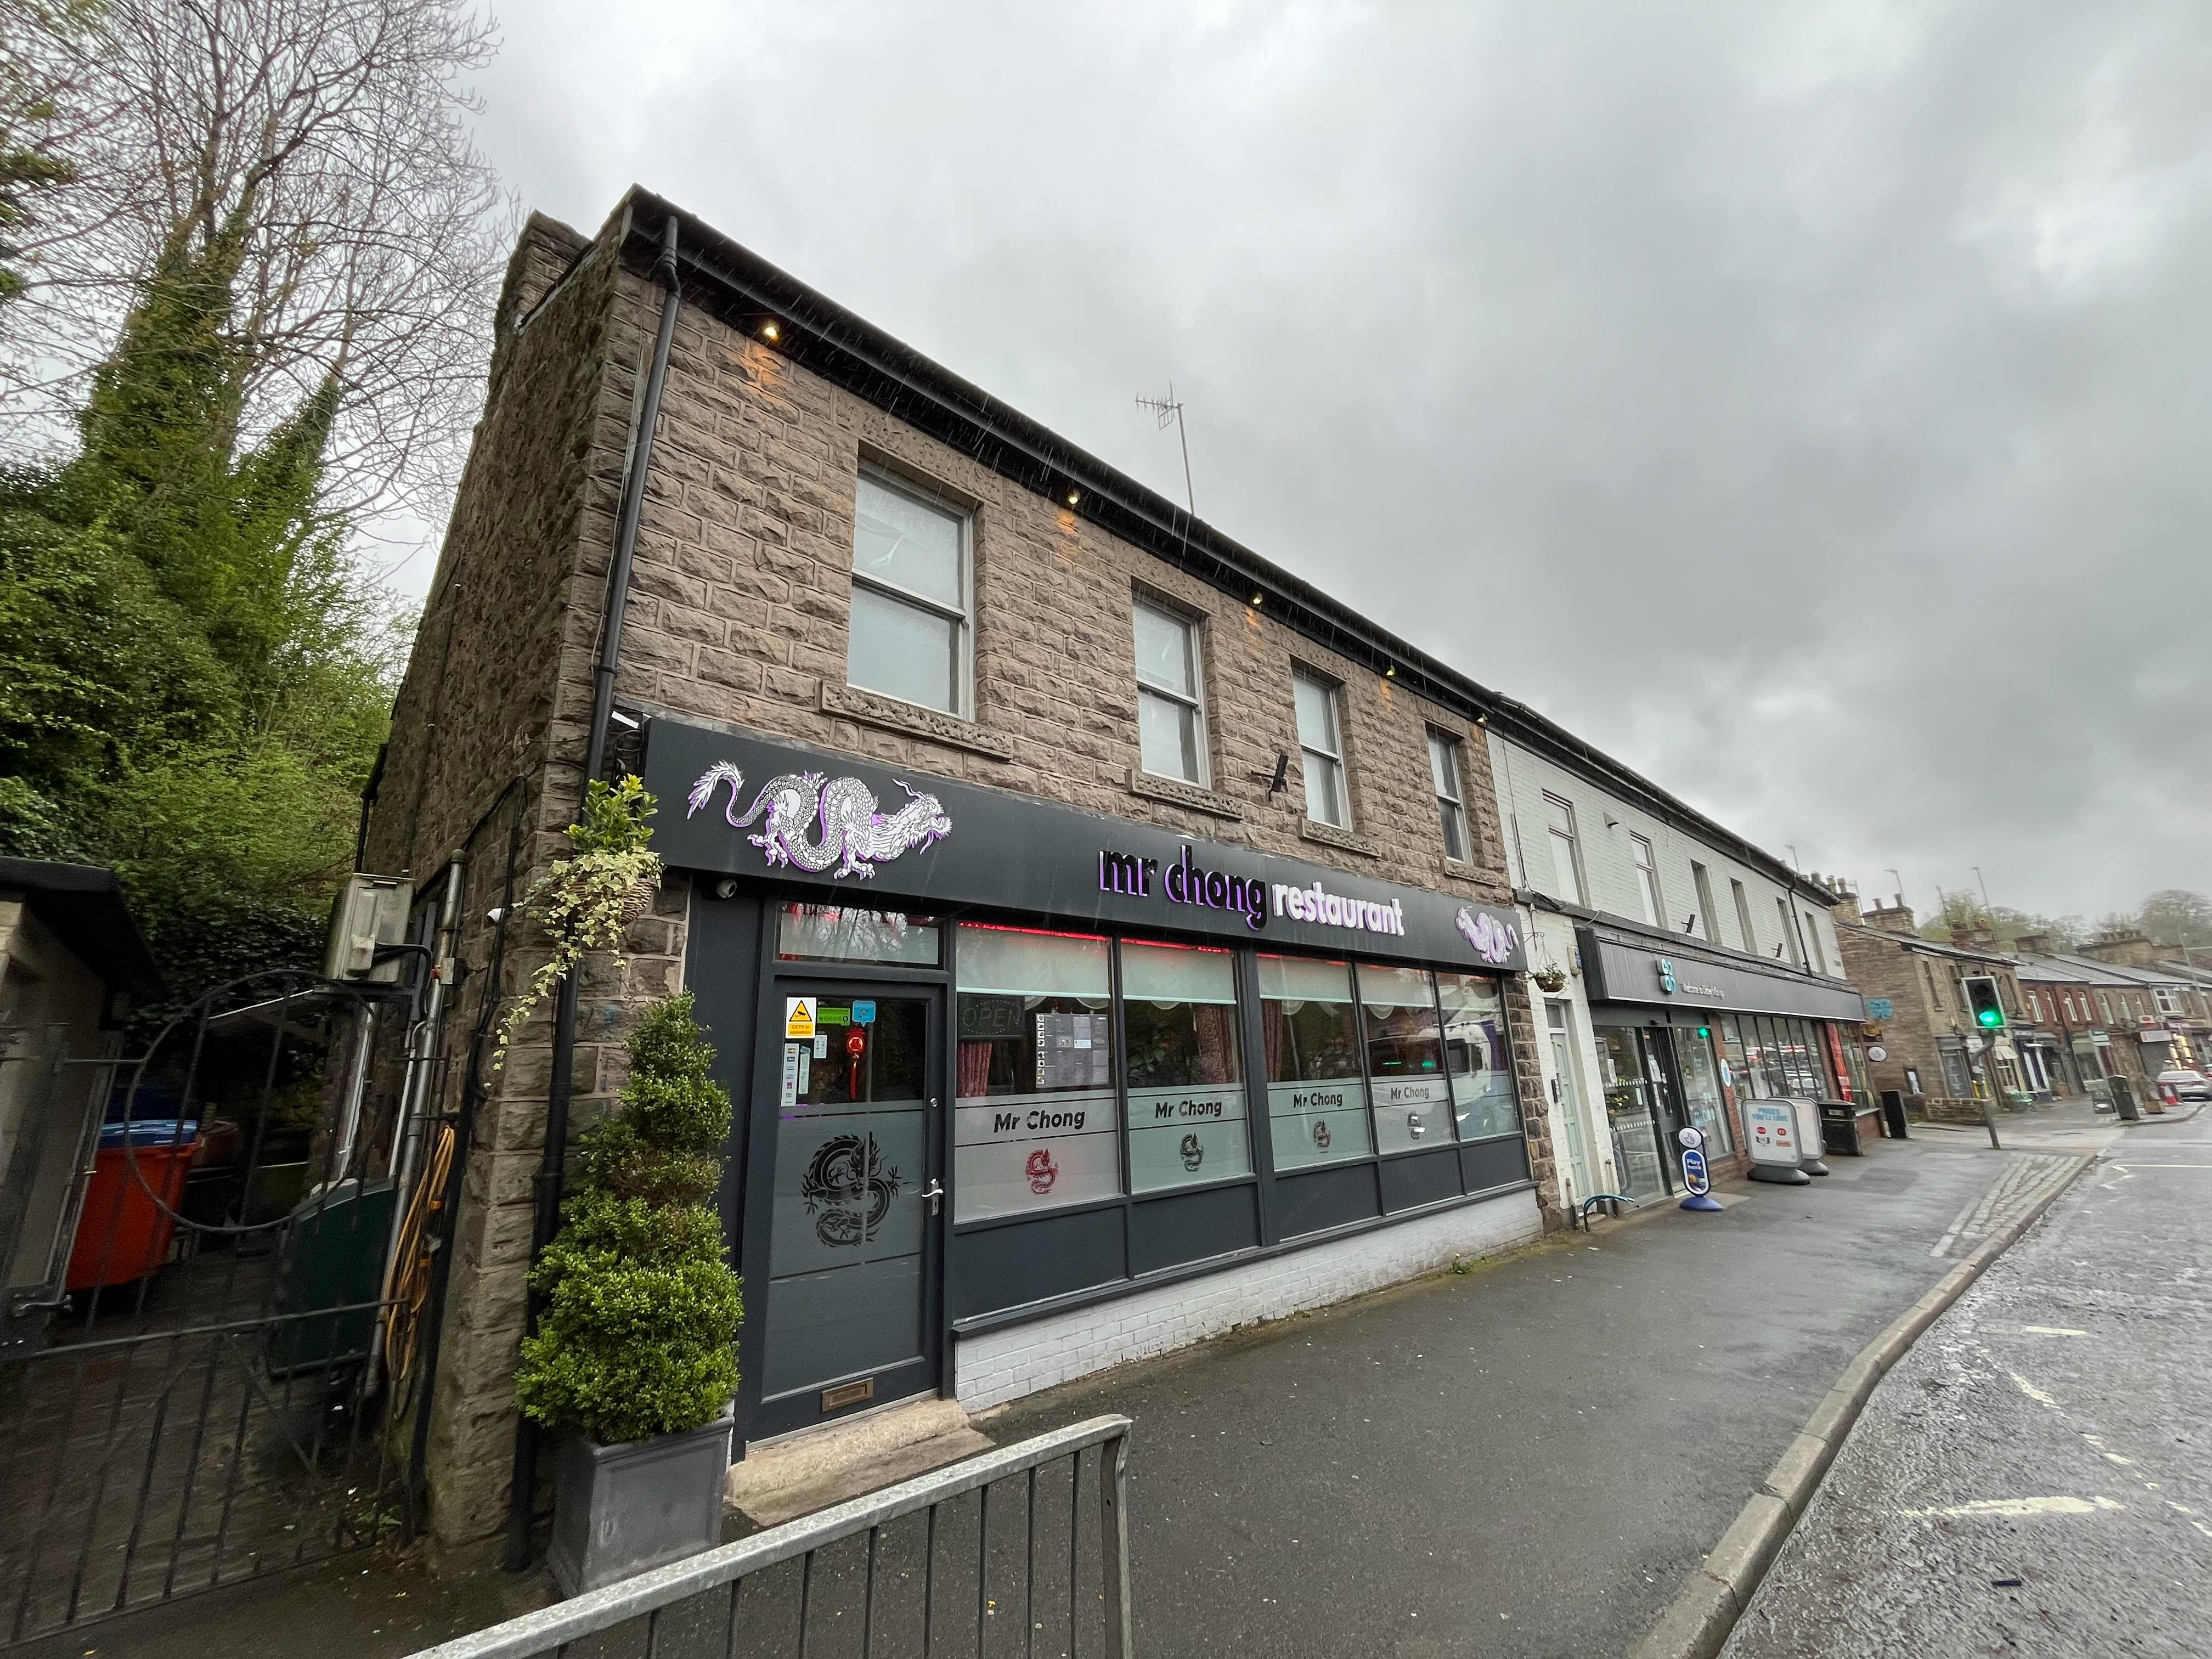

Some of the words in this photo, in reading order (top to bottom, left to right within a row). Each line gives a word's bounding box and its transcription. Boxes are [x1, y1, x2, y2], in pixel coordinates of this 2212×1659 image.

[1099, 850, 1159, 897] mr
[1164, 844, 1267, 931] chong
[1272, 881, 1405, 936] restaurant
[962, 1005, 1023, 1028] OPEN
[1293, 1093, 1308, 1108] Mr
[1310, 1092, 1343, 1107] Chong
[1390, 1087, 1402, 1100] Mr
[1403, 1086, 1430, 1099] Chong
[1155, 1102, 1175, 1119] Mr
[1178, 1100, 1223, 1118] Chong
[993, 1113, 1021, 1133] Mr
[1026, 1110, 1086, 1130] Chong
